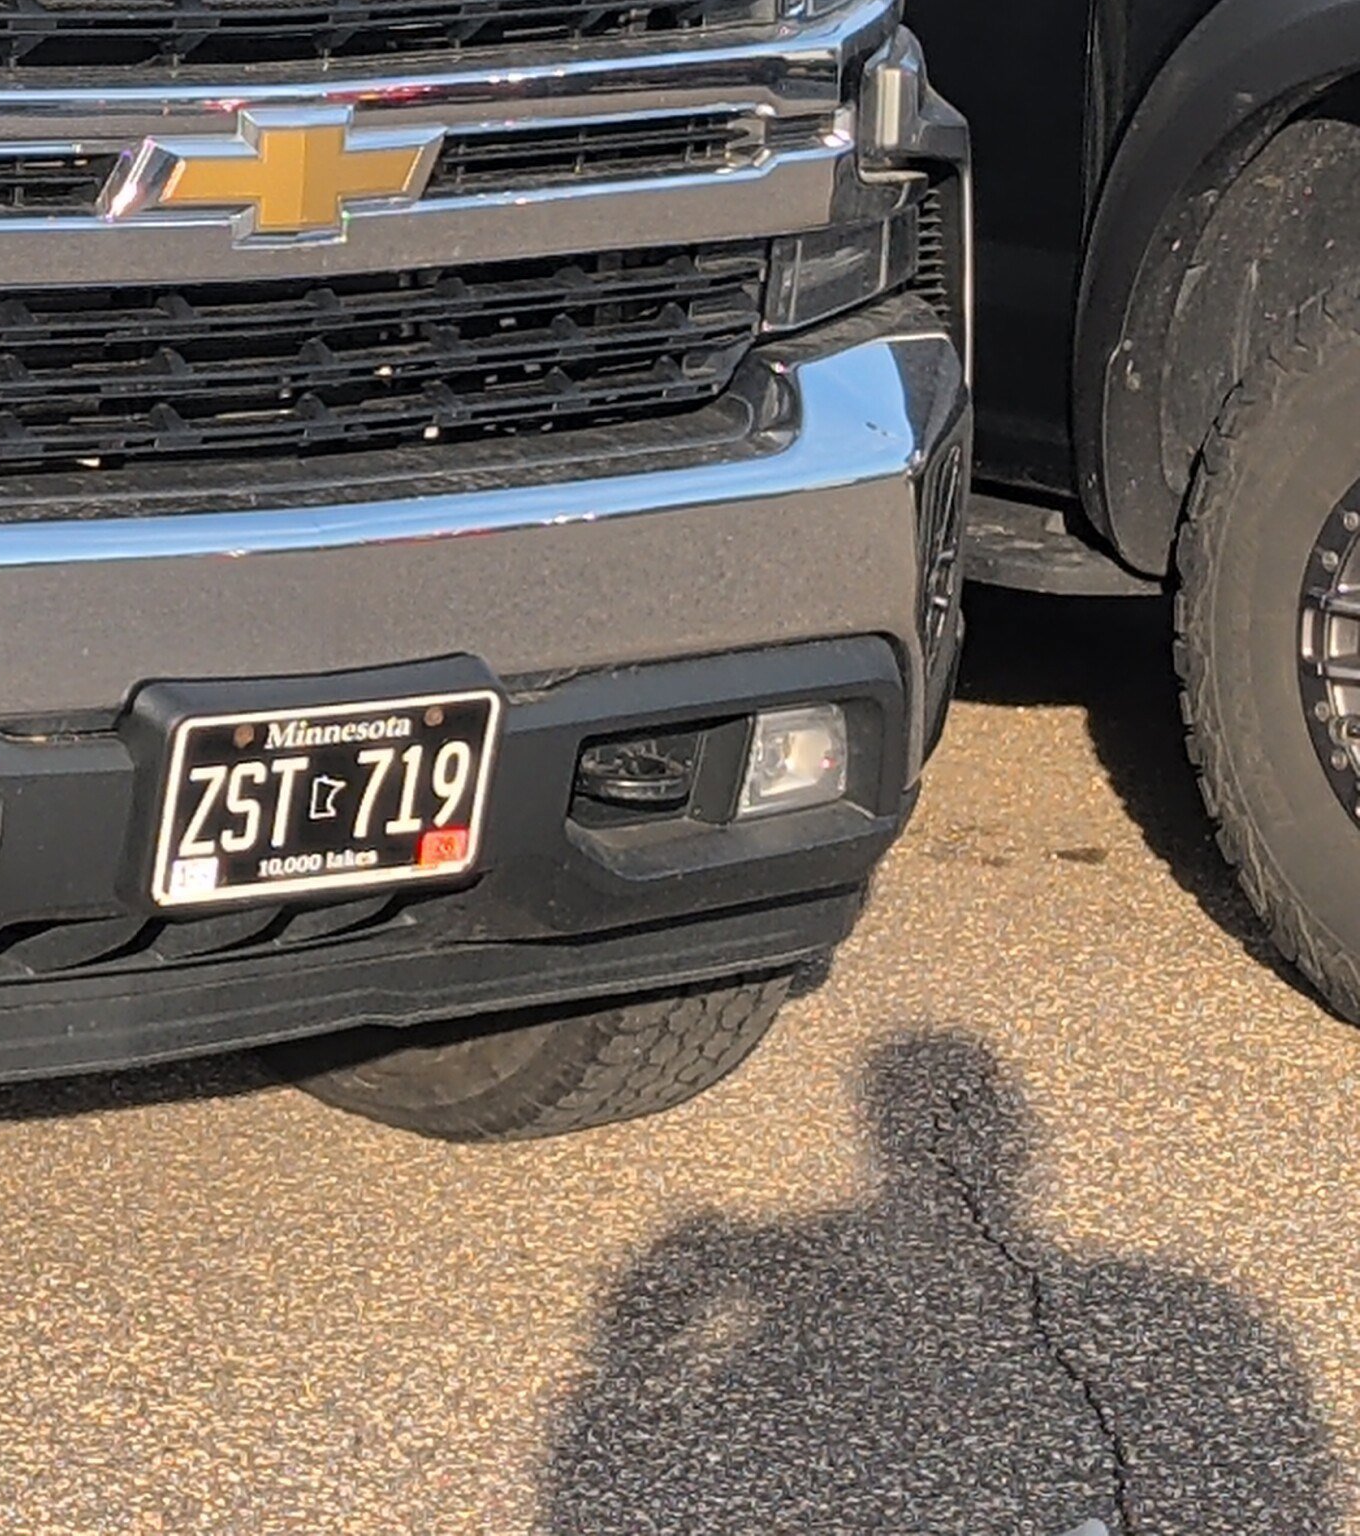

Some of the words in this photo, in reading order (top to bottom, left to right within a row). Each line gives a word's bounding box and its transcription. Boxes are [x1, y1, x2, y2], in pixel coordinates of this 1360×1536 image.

[263, 715, 412, 751] Minnesota
[179, 756, 310, 858] ZST
[352, 739, 472, 839] 719
